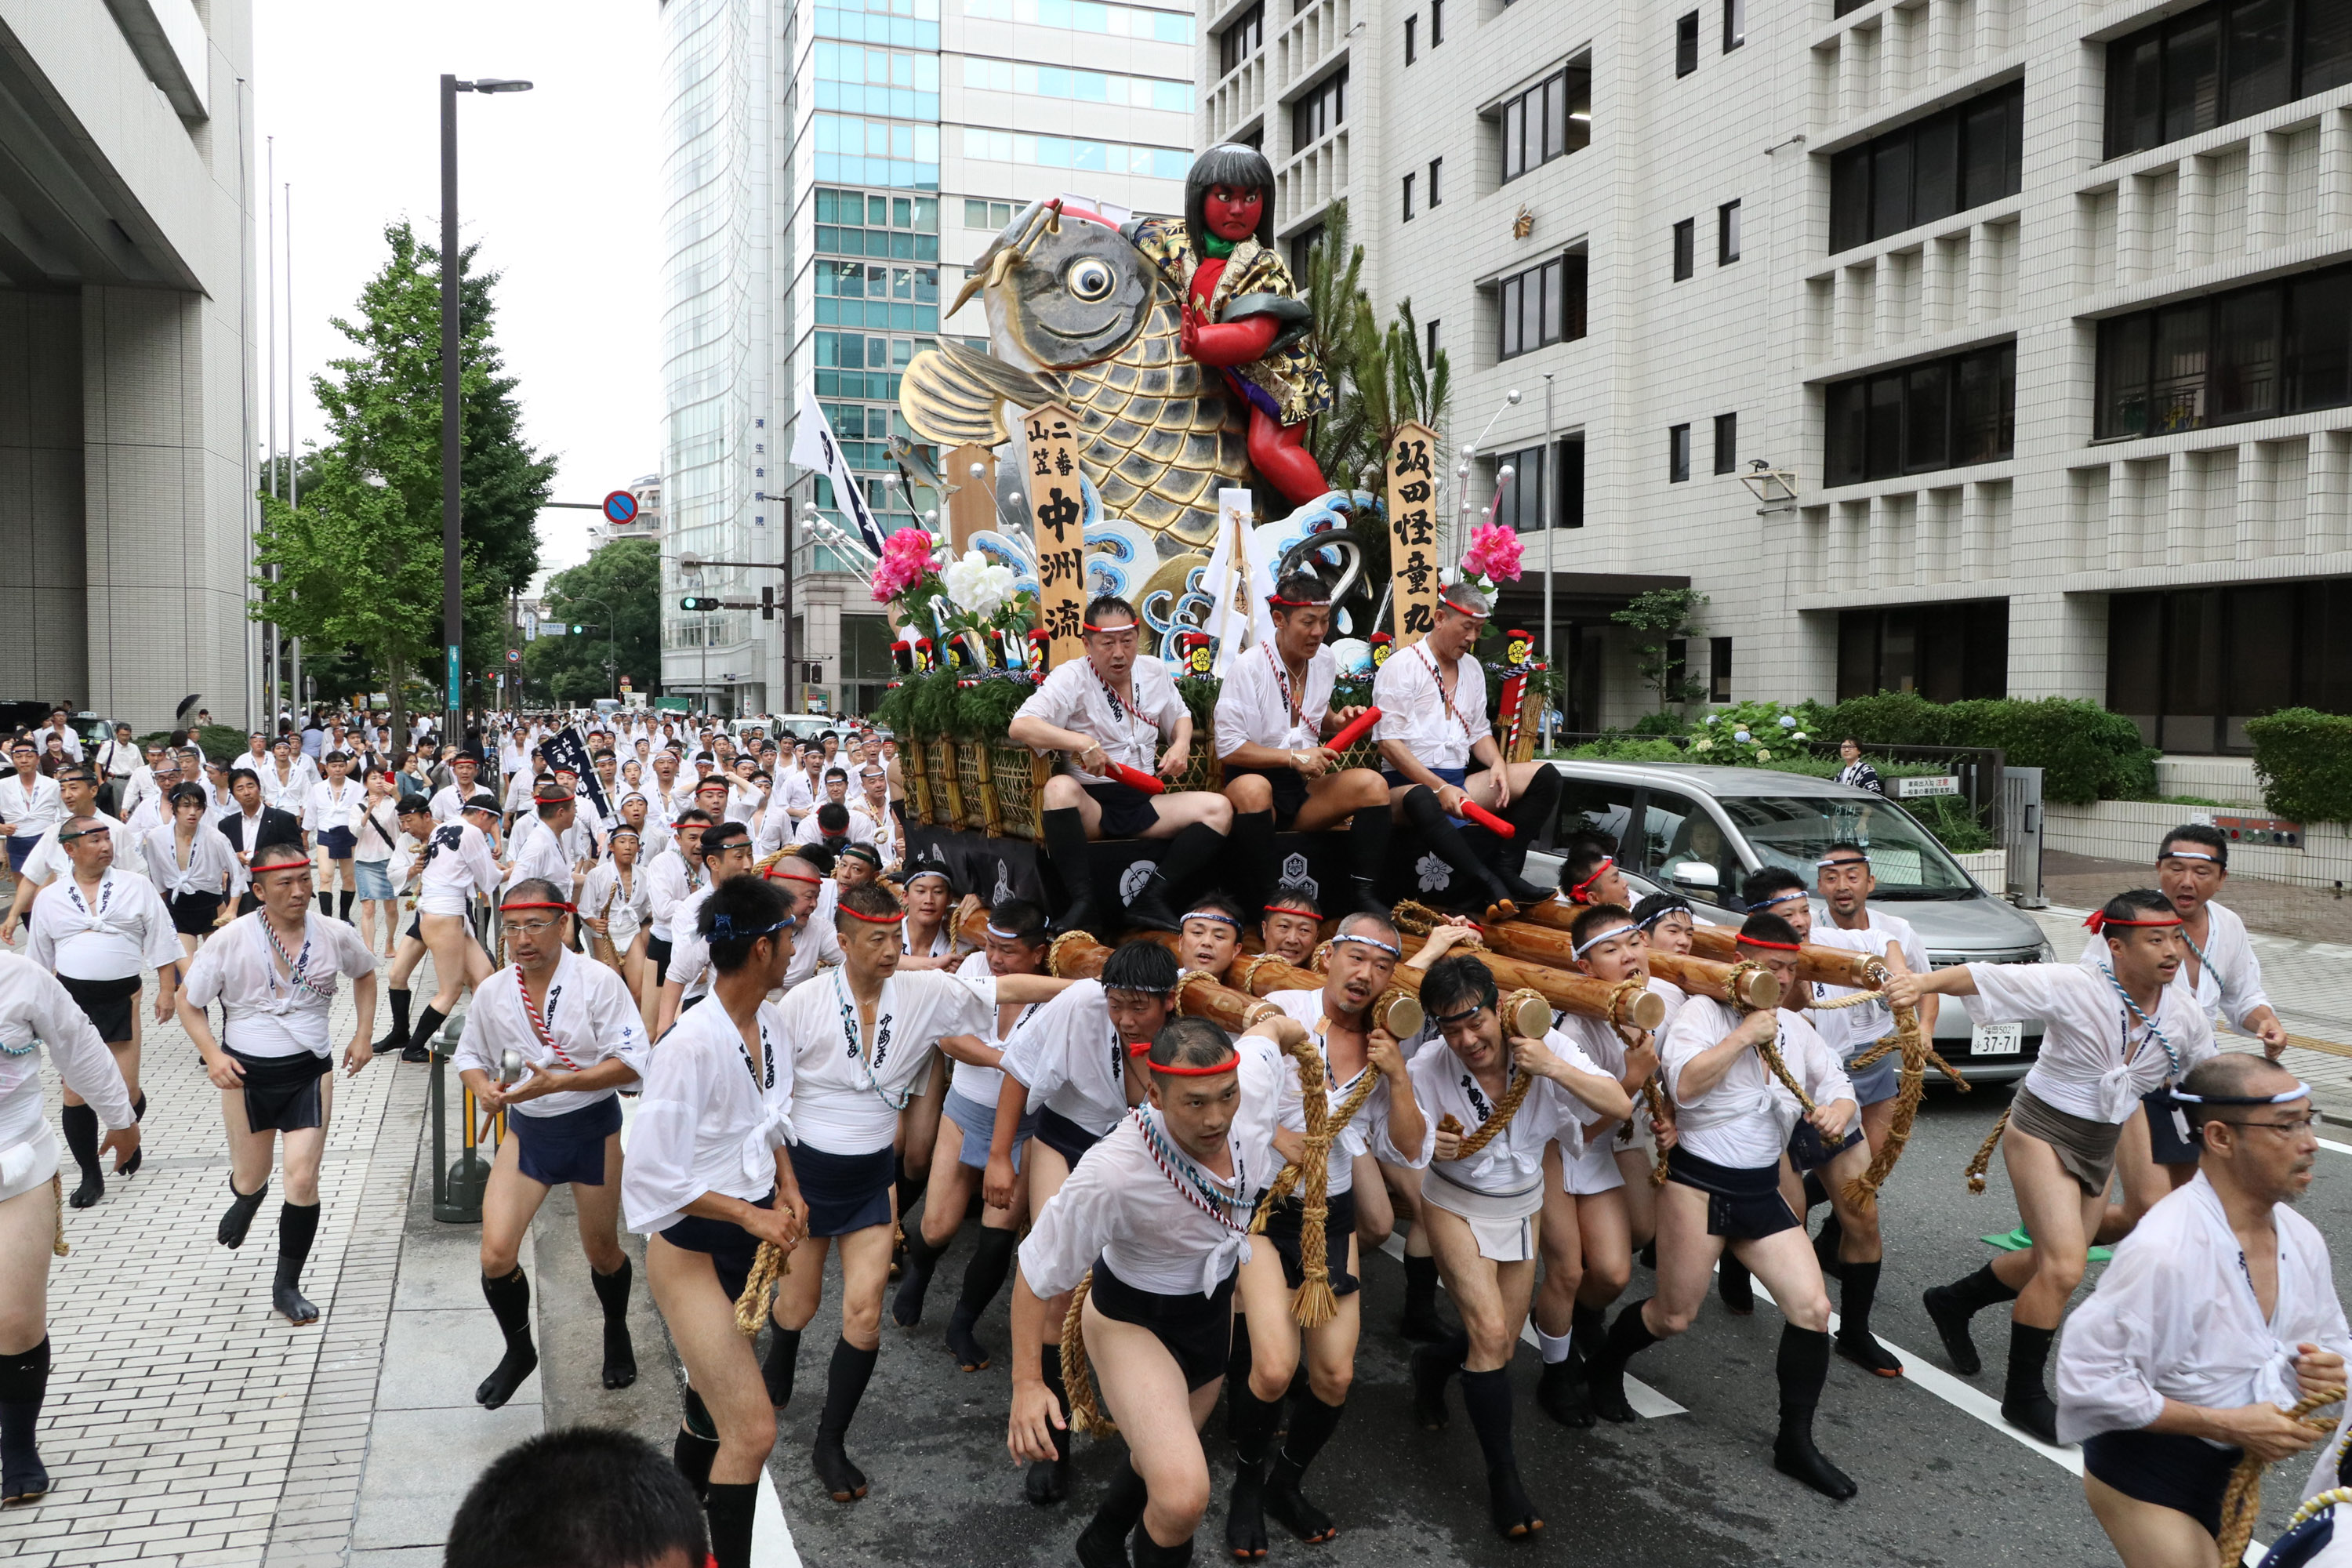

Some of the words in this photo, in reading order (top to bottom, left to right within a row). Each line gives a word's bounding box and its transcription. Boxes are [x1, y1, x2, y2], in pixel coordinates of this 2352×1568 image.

[755, 419, 764, 526] 済生会病院
[1028, 420, 1052, 476] 山笠
[1051, 421, 1074, 477] 二番
[1037, 487, 1085, 641] 中洲流
[1393, 440, 1435, 635] 坂田怪童丸
[1983, 1035, 2016, 1052] 37-71
